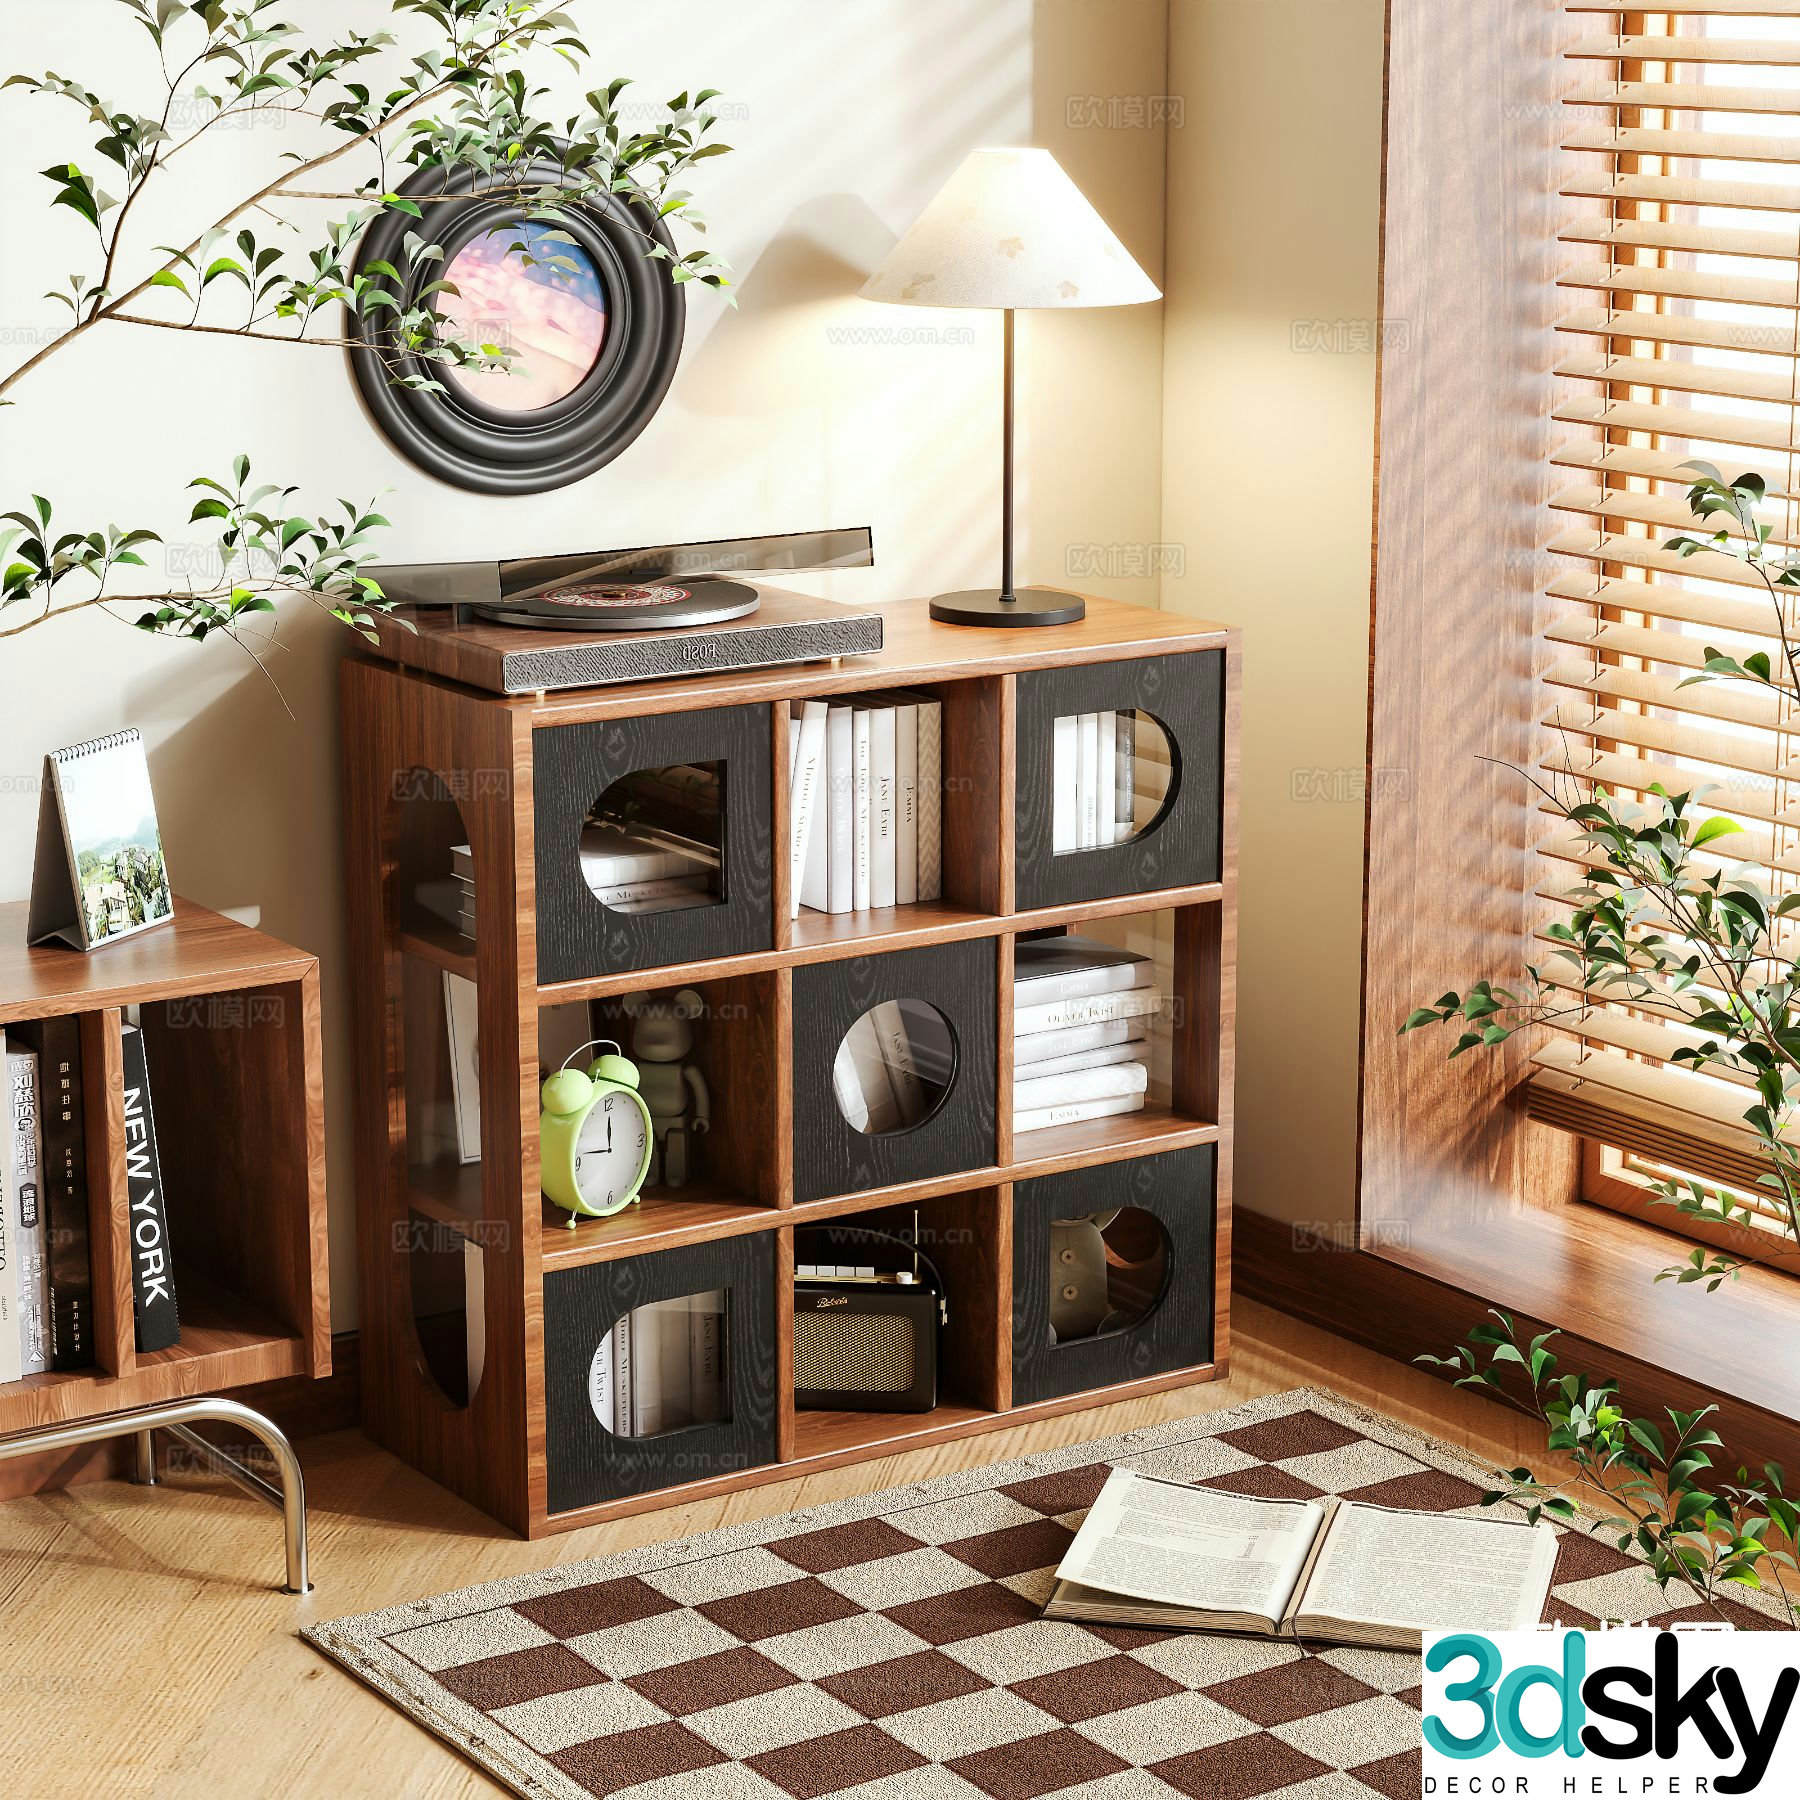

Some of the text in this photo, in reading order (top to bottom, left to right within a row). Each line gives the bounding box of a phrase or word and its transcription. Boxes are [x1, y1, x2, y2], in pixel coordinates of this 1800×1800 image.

[879, 776, 891, 804] JANE
[1086, 1006, 1114, 1018] TWIST
[604, 1097, 614, 1113] 12
[636, 1133, 645, 1148] 3
[575, 1157, 581, 1172] 9
[124, 1086, 170, 1308] NEW YORK
[607, 1190, 613, 1205] 6
[596, 1367, 607, 1403] TWIST
